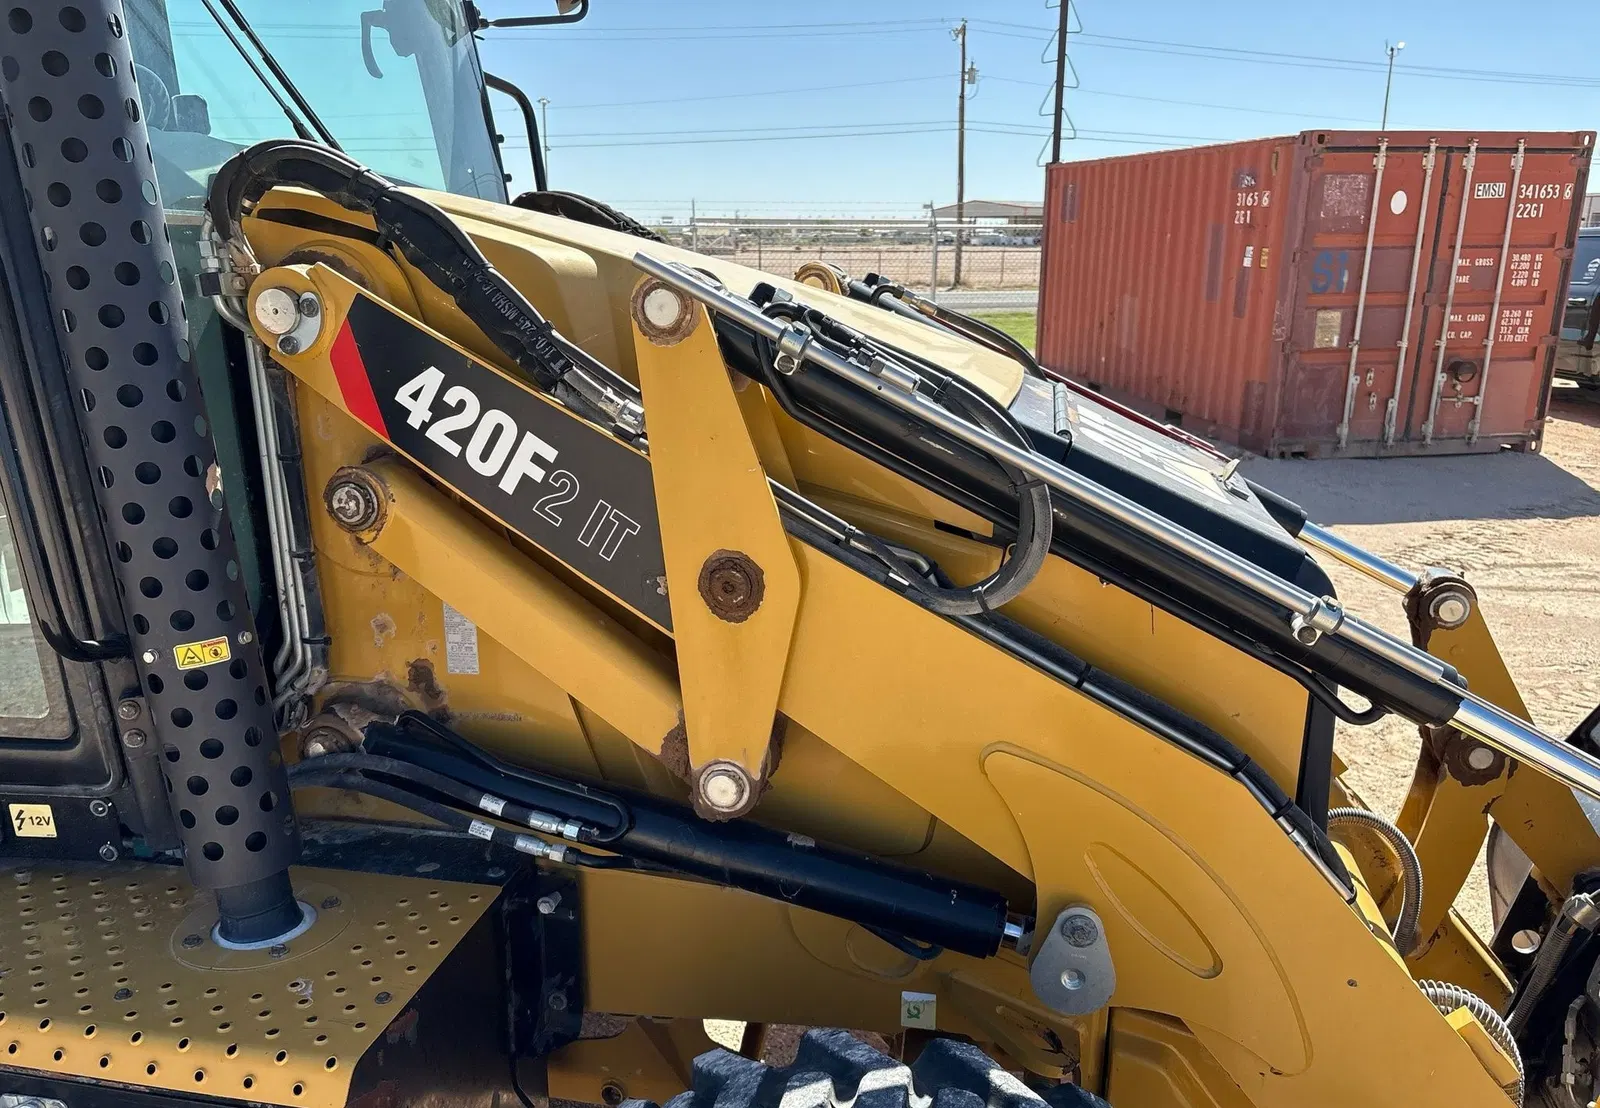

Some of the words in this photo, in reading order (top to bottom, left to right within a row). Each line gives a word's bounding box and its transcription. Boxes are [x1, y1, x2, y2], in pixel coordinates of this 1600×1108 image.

[1475, 183, 1505, 198] EMSU
[1518, 184, 1560, 199] 341653
[1563, 183, 1574, 199] 6
[1516, 203, 1544, 218] 22G1
[1475, 258, 1494, 266] GROSS
[1535, 254, 1543, 262] KG
[1534, 262, 1542, 270] LB
[1456, 275, 1470, 283] TARE
[1531, 279, 1539, 287] LB
[1467, 314, 1486, 322] CARGO
[1524, 318, 1532, 326] LB
[577, 499, 641, 562] IT
[28, 816, 50, 826] 12V
